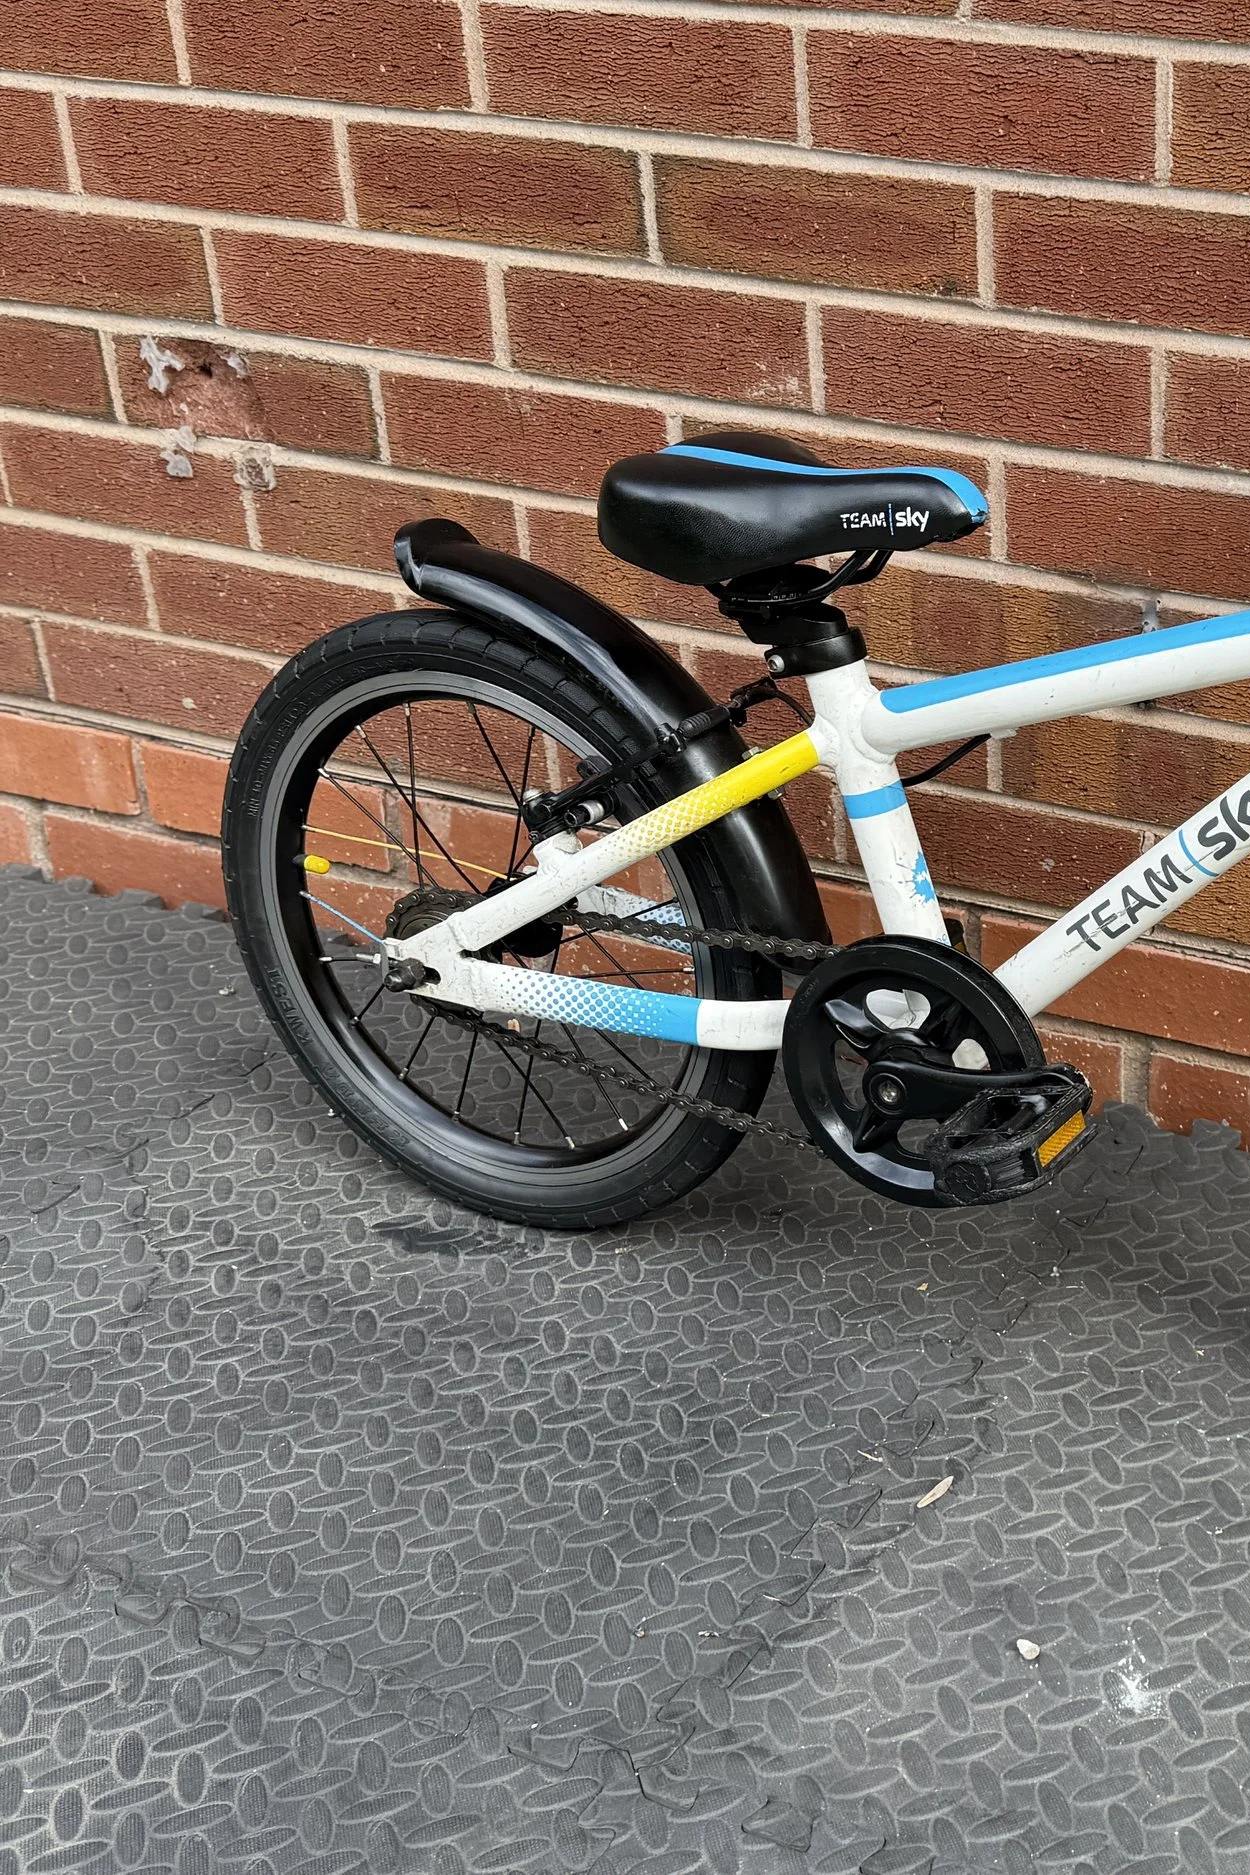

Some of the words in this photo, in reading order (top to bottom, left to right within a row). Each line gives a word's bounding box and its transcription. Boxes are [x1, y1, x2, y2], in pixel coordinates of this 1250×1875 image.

[839, 511, 887, 530] TEAM
[1066, 854, 1194, 952] TEAM
[264, 966, 312, 1046] KWEST
